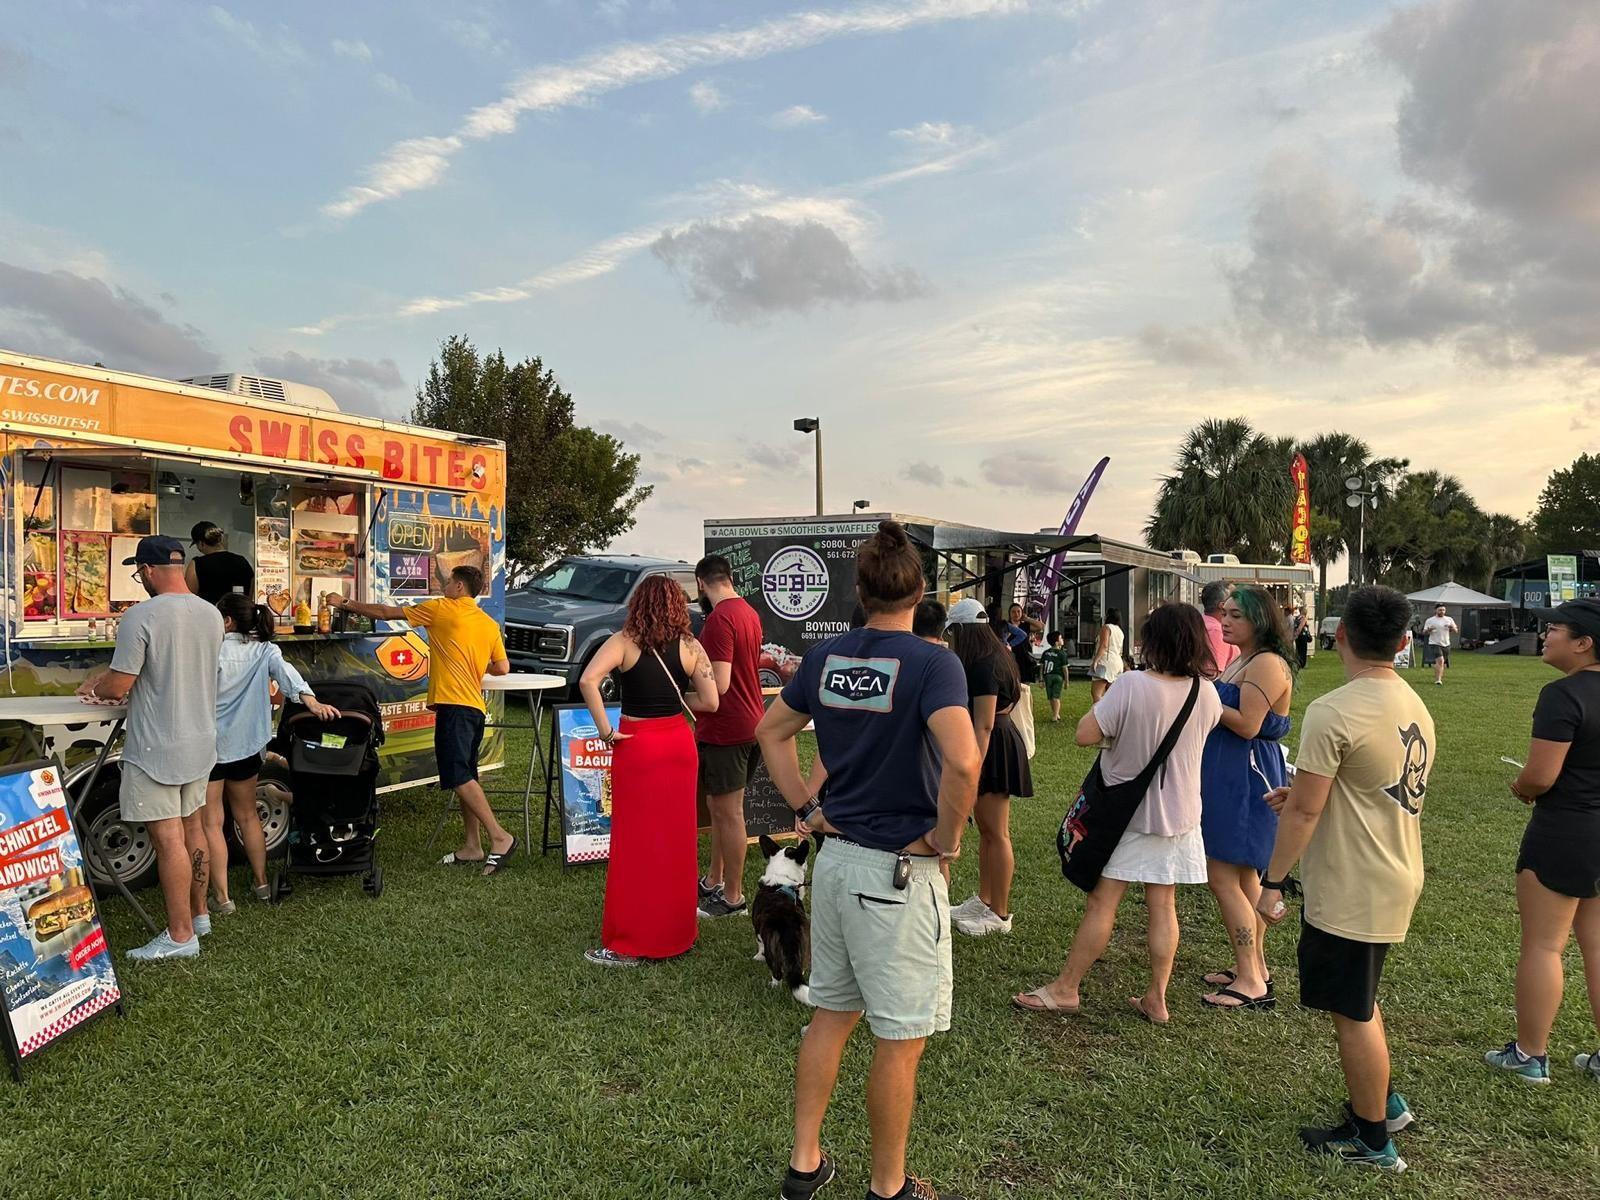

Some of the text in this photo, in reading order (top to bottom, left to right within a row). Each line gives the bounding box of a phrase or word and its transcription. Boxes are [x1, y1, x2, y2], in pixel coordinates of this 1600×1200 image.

[229, 415, 487, 490] SWISS BITES
[391, 524, 432, 547] OPEN
[718, 524, 878, 537] ACAI BOWLS SMOOTHIES WAFFLES
[805, 621, 850, 632] BOYNTON
[830, 673, 883, 693] RVCA
[404, 702, 420, 713] THE
[74, 934, 104, 961] ORDER NOW
